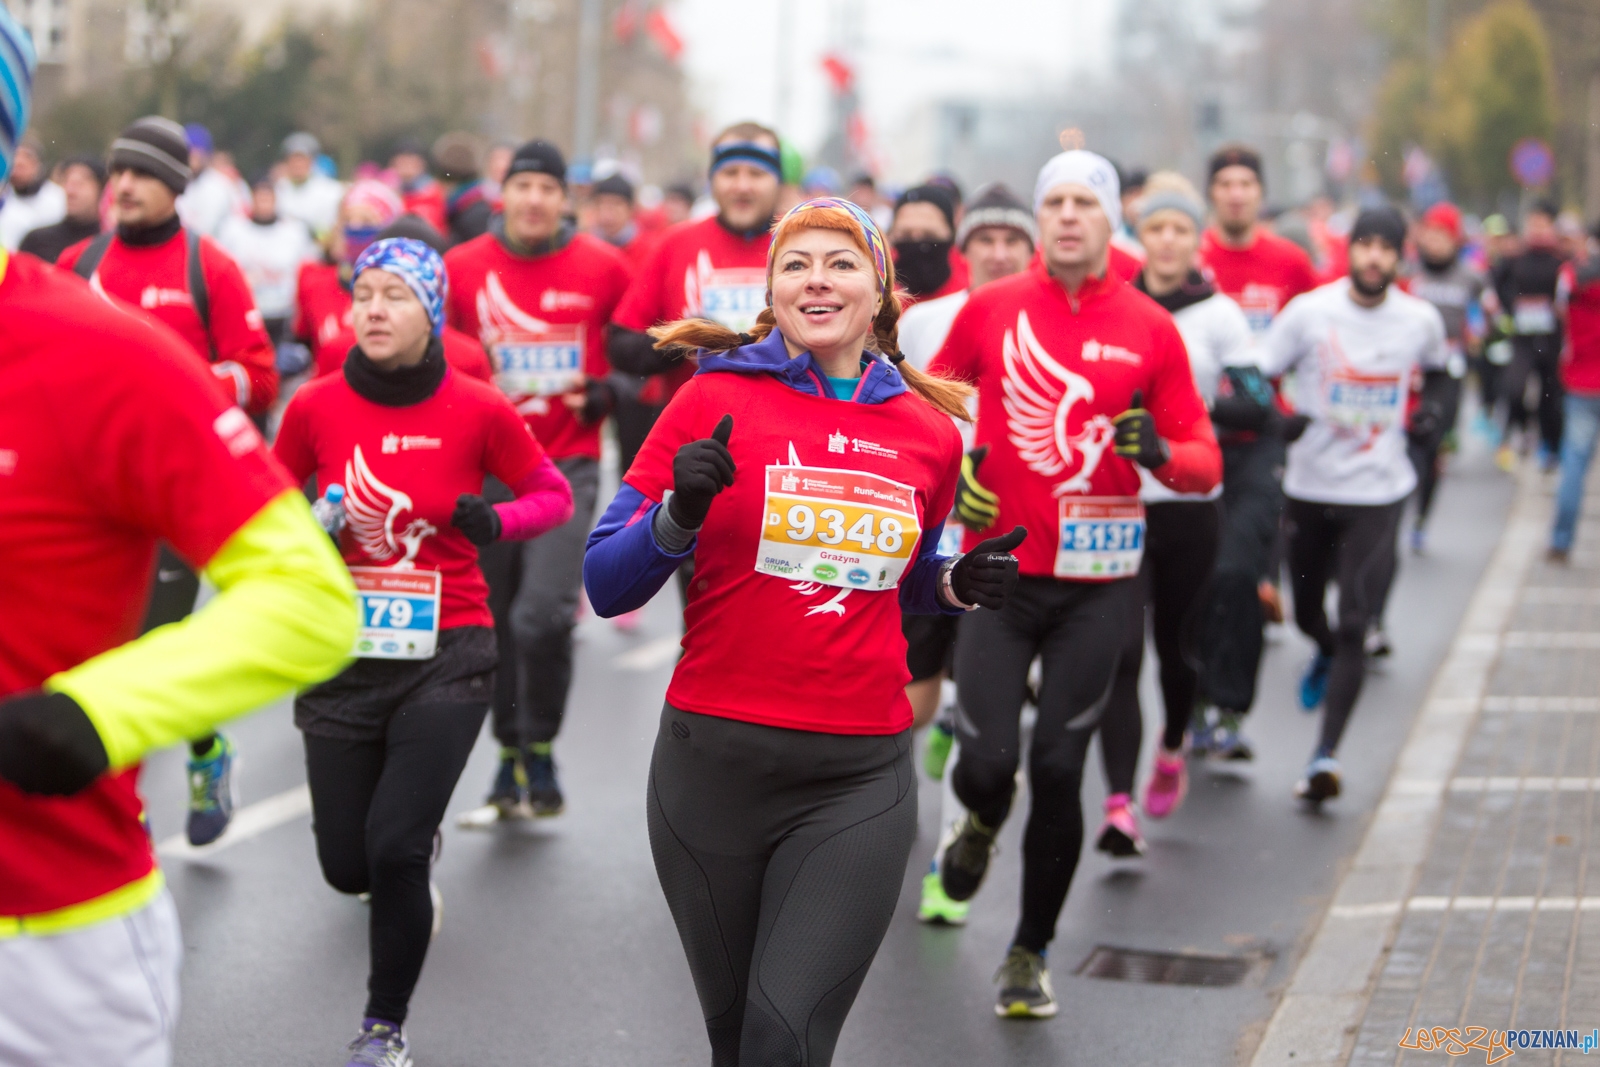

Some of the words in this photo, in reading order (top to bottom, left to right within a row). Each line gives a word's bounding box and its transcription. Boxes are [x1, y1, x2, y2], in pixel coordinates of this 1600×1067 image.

[853, 486, 907, 507] RunPoland.org
[768, 512, 781, 526] D
[786, 504, 903, 553] 9348
[1073, 524, 1135, 550] 5131
[764, 557, 790, 567] GRUPA
[820, 551, 860, 564] Grażyna
